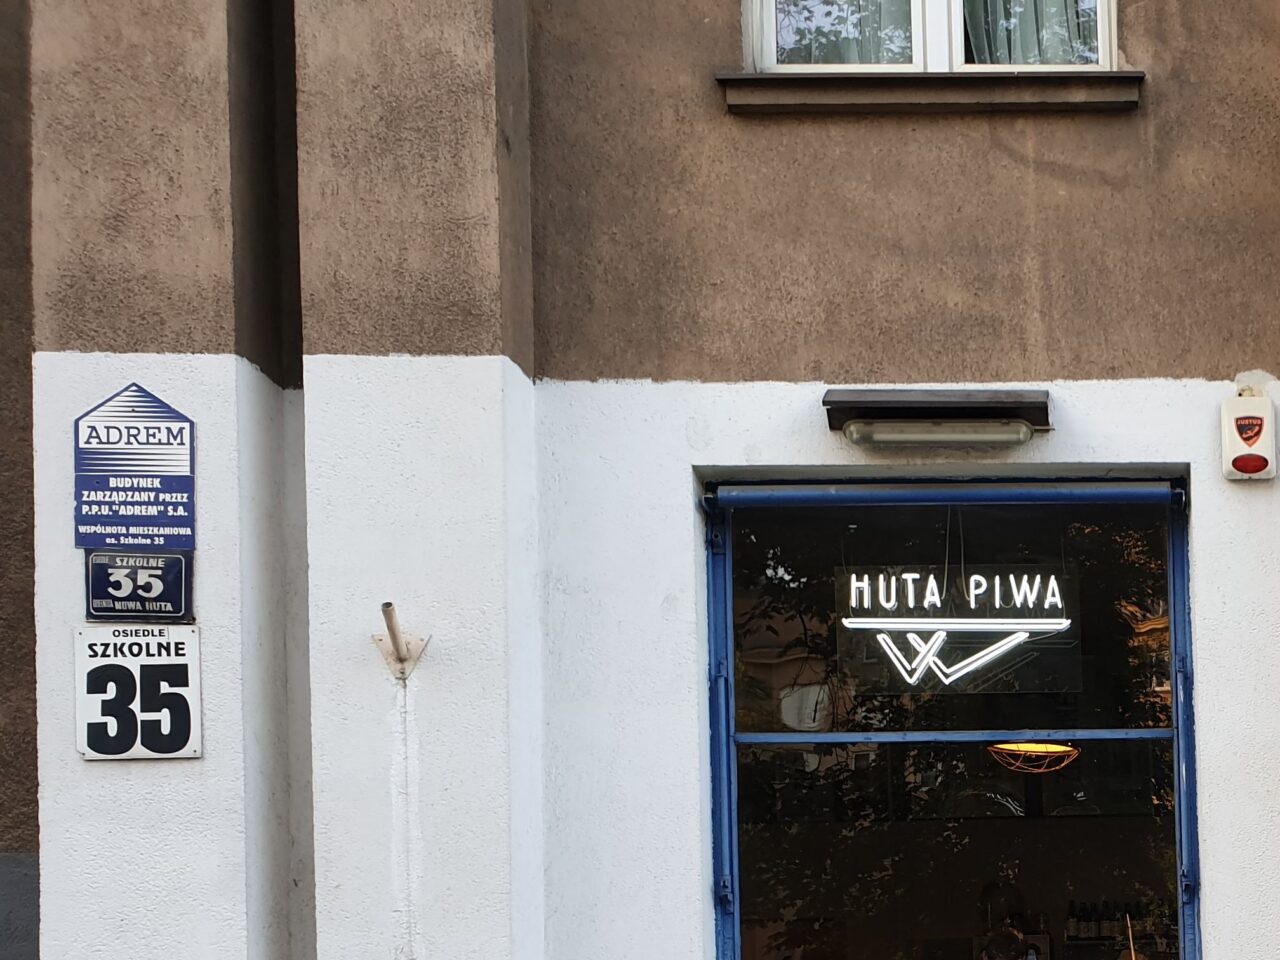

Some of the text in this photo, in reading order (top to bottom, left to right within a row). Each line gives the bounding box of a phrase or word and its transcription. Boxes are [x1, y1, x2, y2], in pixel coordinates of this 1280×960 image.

[84, 425, 186, 446] ADREM
[109, 477, 162, 489] BUDYNEK
[81, 491, 188, 504] ZARZĄDZANY PRZEZ
[167, 506, 188, 517] S.A.
[78, 523, 192, 536] WSPÓLNOTA MIESZKANIOWA
[119, 536, 151, 545] Szkolne
[153, 537, 165, 545] 35
[115, 556, 166, 567] SZKOLNE
[107, 568, 164, 598] 35
[850, 573, 1063, 610] HUTA PIWA
[114, 601, 142, 611] NOWA
[145, 601, 174, 611] HUTA
[112, 629, 166, 638] OSIEDLE
[87, 641, 187, 658] SZKOLNE
[86, 663, 191, 755] 35
